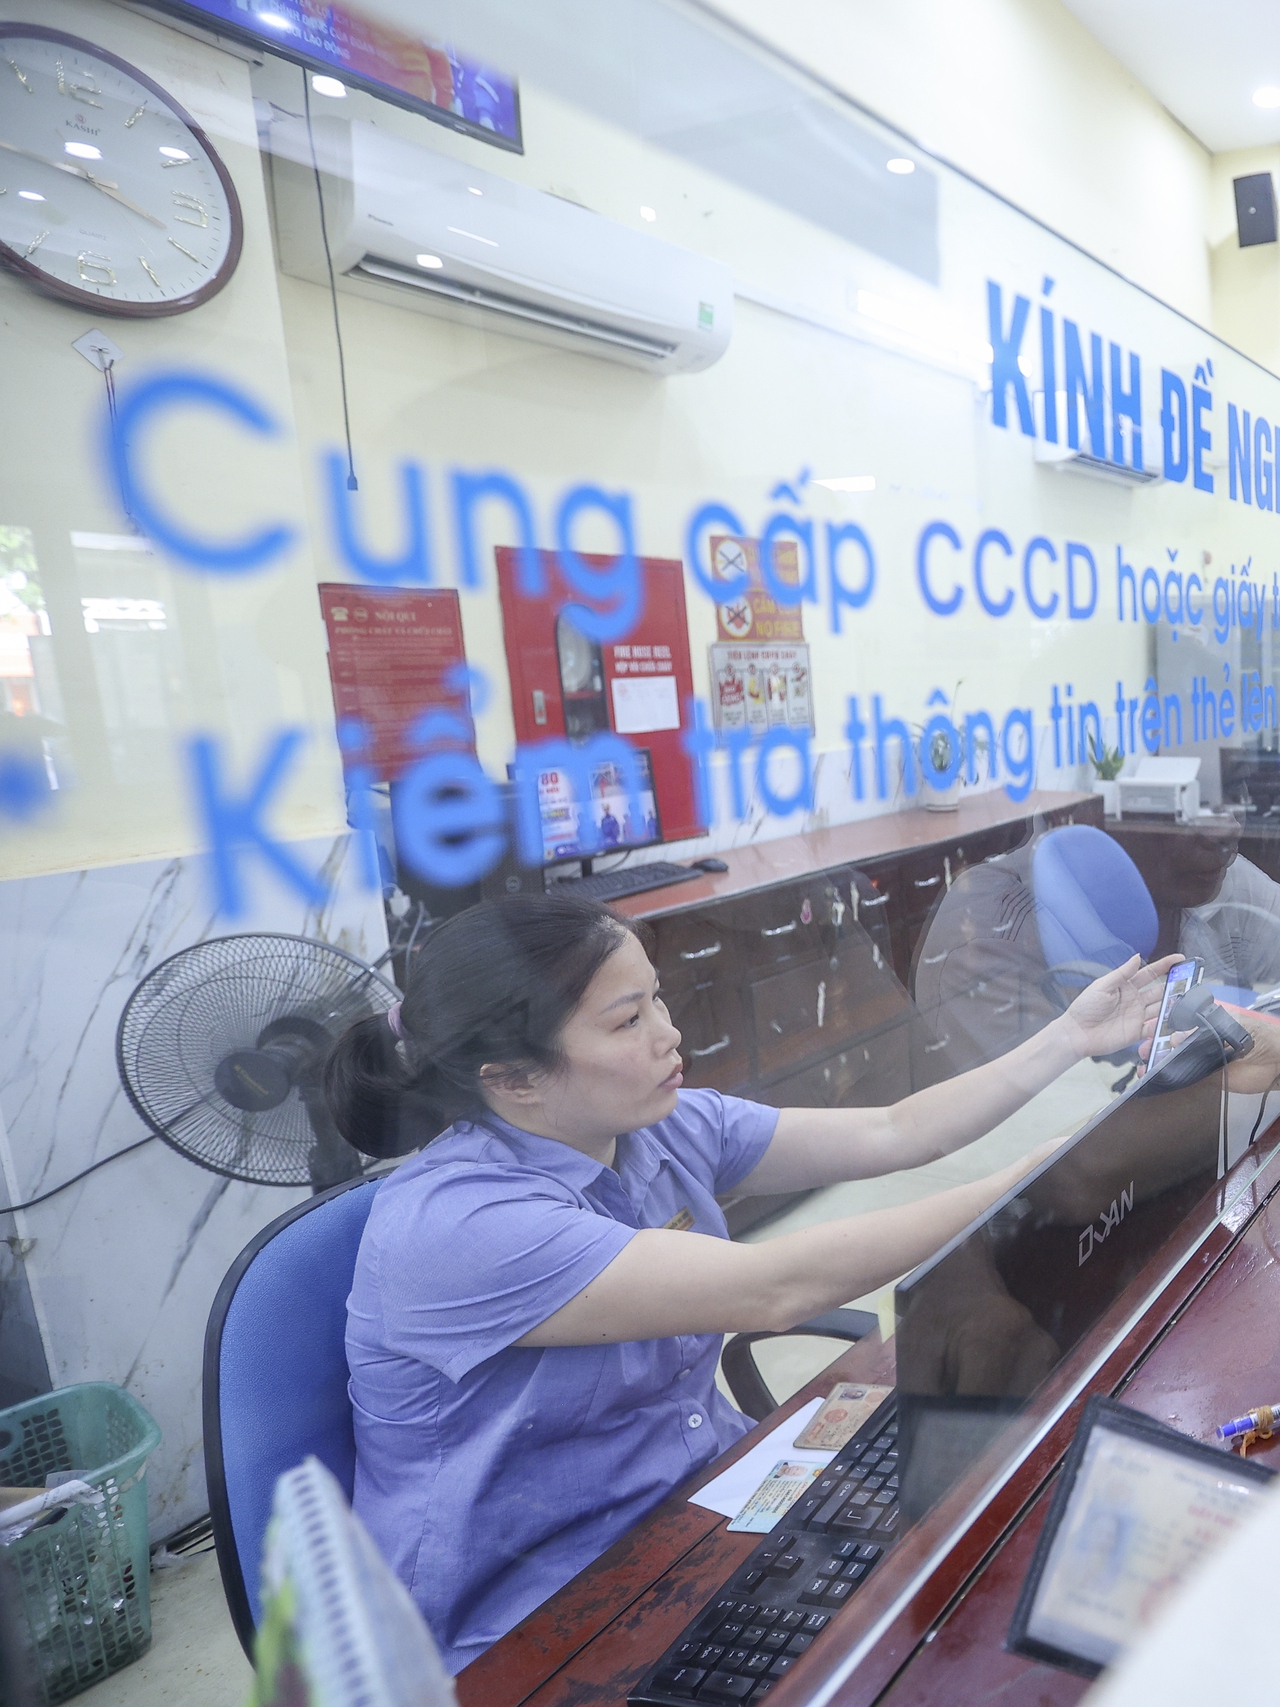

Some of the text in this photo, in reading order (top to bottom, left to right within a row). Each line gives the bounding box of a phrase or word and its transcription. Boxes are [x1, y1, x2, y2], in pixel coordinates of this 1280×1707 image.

[65, 119, 99, 136] KASHI
[171, 189, 209, 229] 3
[77, 250, 117, 287] 6
[985, 272, 1145, 473] KÍNH
[1161, 357, 1214, 494] ĐỀ
[103, 370, 642, 642] Cung
[686, 466, 877, 635] cấp
[916, 519, 1098, 621] CCCD
[1116, 545, 1203, 643] hoặc
[1213, 555, 1265, 644] giấy
[755, 620, 773, 638] NO
[182, 660, 652, 918] Kiểm
[684, 696, 816, 829] tra
[844, 688, 1036, 804] thông
[1051, 682, 1104, 769] tin
[1115, 676, 1182, 758] trên
[1191, 661, 1236, 743] thẻ
[1242, 670, 1277, 734] lên
